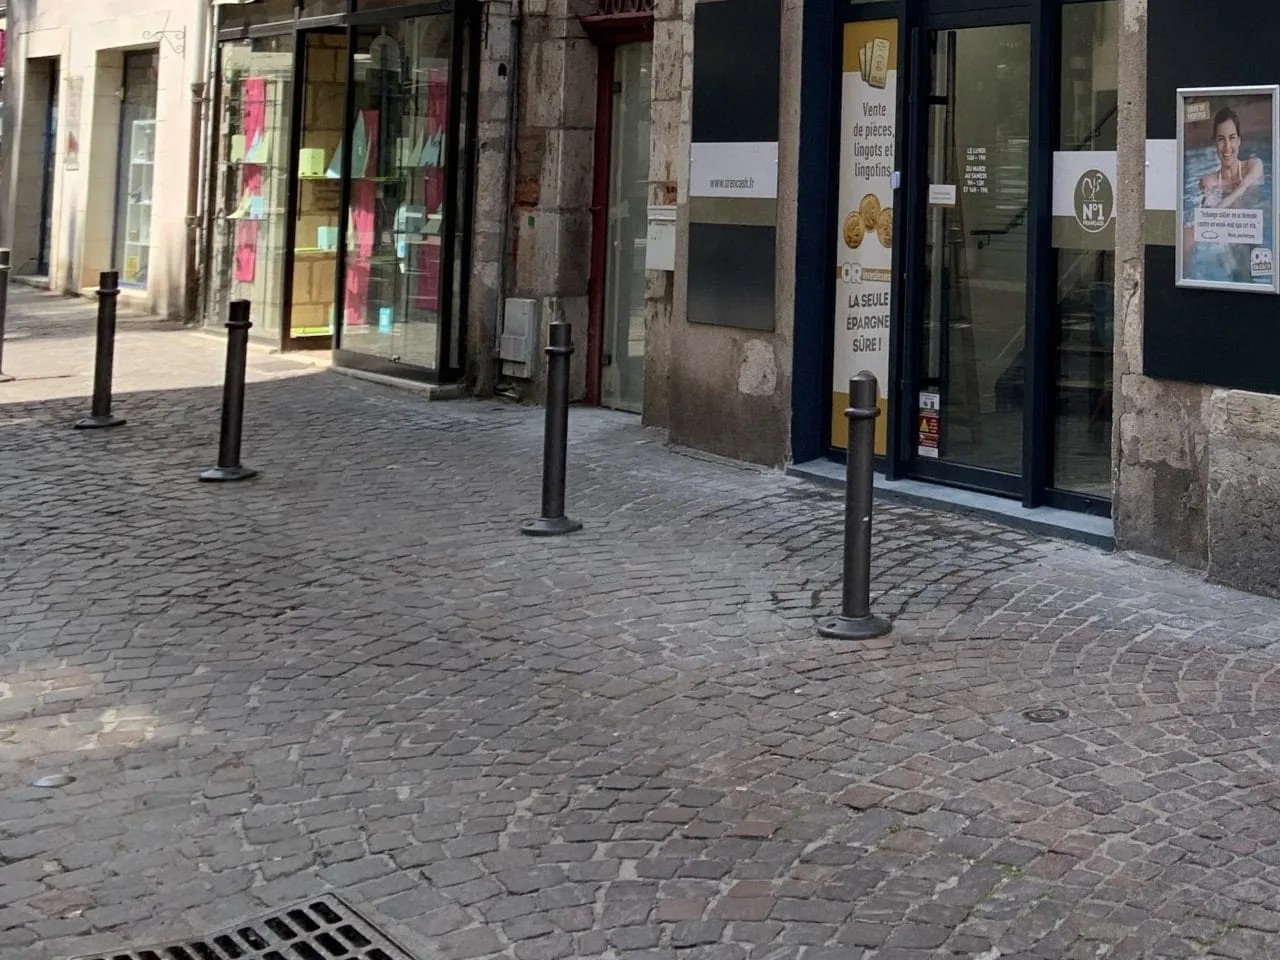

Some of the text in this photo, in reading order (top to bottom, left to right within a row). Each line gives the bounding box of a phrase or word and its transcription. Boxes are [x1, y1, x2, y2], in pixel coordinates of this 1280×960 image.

[863, 102, 886, 117] Vente
[853, 122, 895, 140] de pièces,
[854, 142, 894, 160] lingots et
[855, 163, 891, 180] lingotins
[841, 262, 863, 284] OR
[848, 292, 888, 308] LA SEULE
[846, 313, 890, 330] ÉPARGNE
[853, 335, 876, 352] SÛRE
